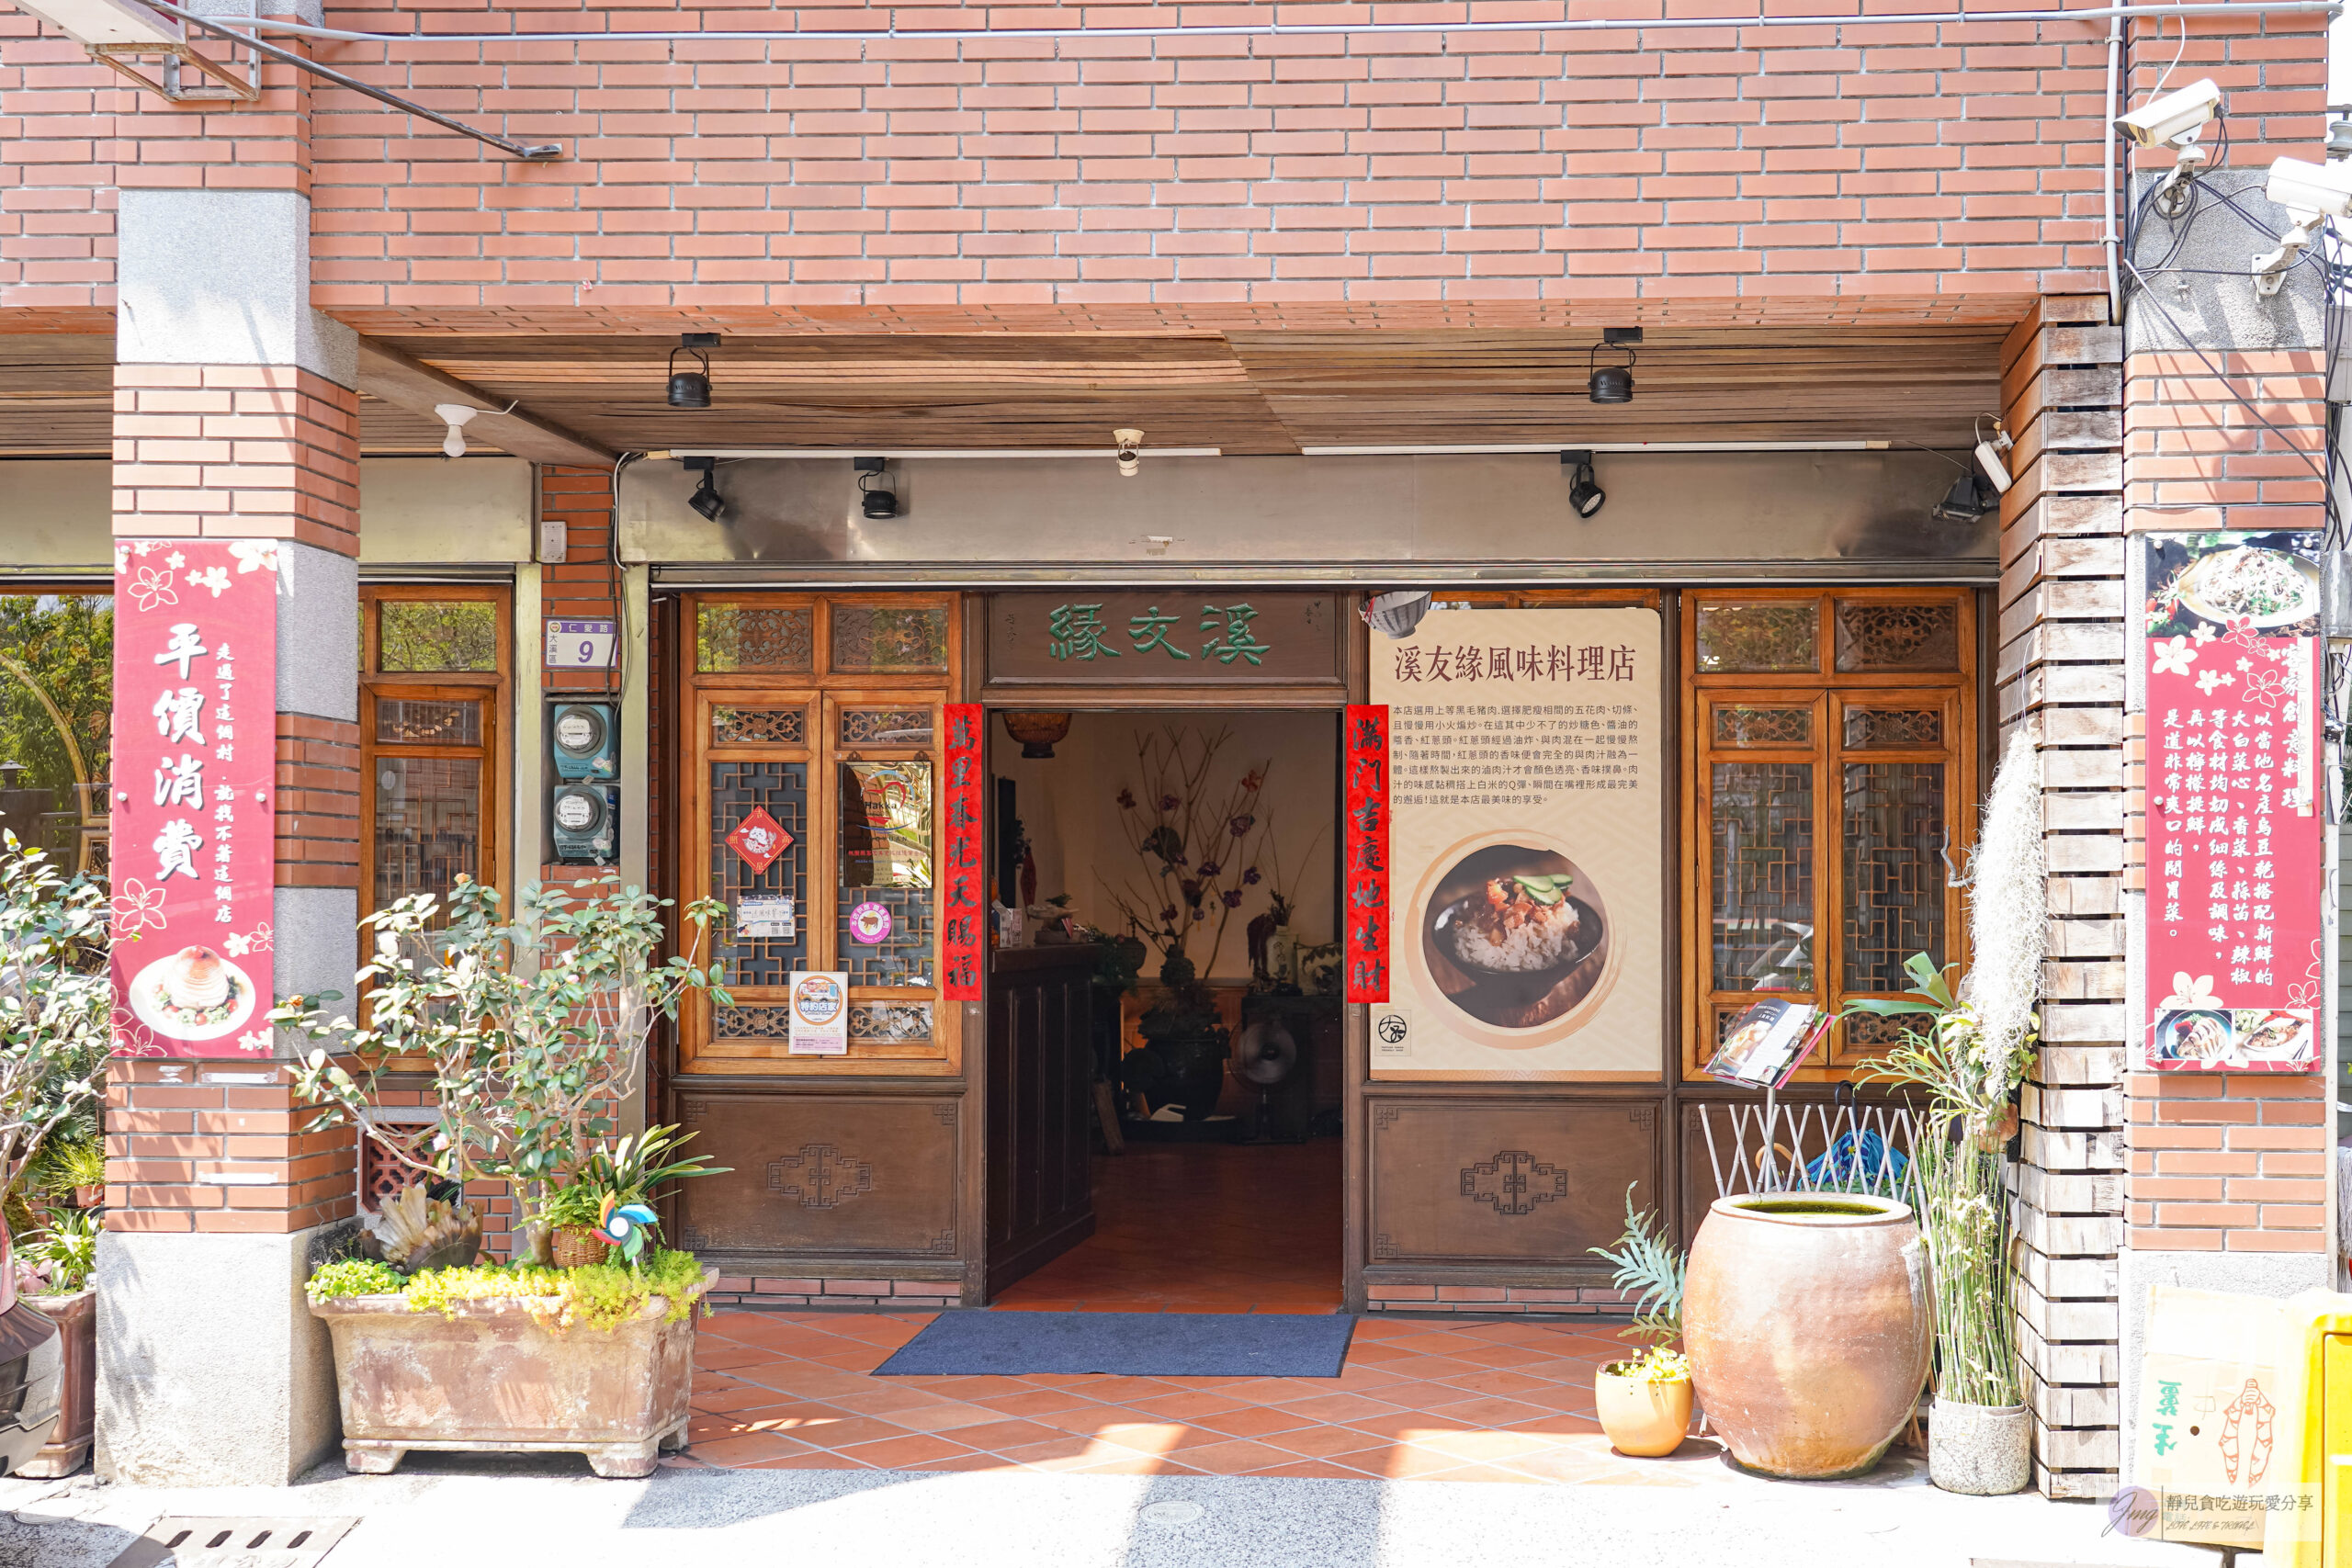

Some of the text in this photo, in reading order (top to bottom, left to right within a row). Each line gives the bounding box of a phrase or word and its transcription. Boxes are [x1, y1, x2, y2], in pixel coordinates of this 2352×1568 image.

[569, 624, 608, 633] 仁愛路
[578, 640, 594, 663] 9
[1395, 644, 1637, 682] 溪友緣風味料理店
[153, 623, 209, 881] 平價消費
